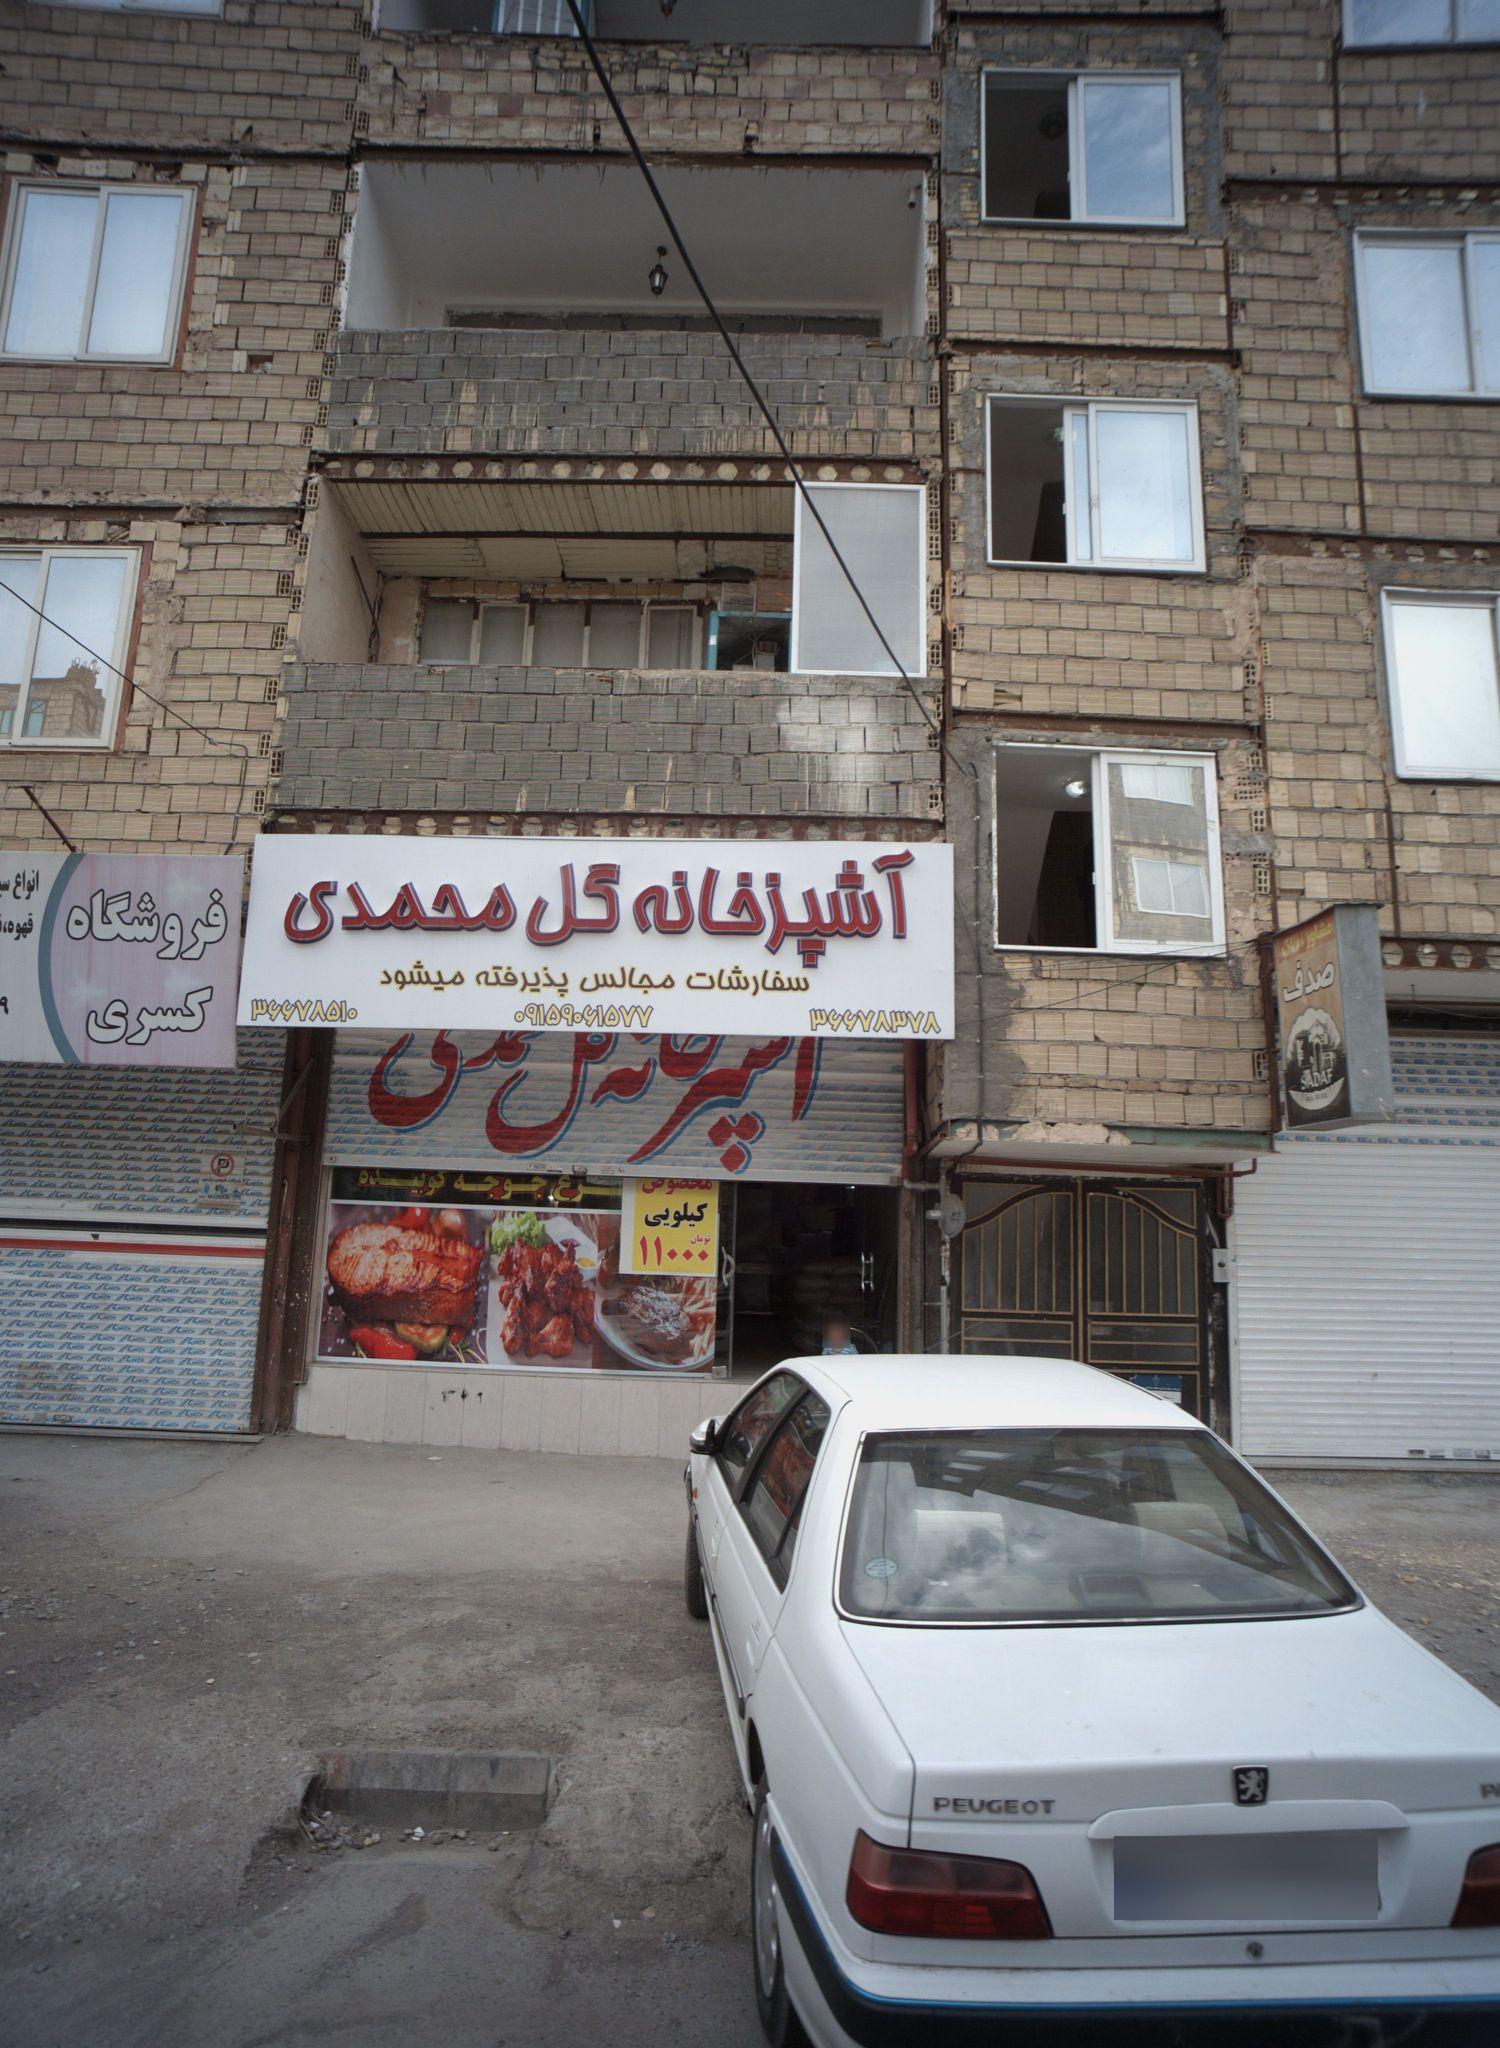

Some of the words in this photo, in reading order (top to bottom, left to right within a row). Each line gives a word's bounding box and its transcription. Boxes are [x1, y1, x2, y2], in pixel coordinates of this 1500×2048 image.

[13, 869, 39, 900] انواع
[284, 880, 517, 944] محمدی
[526, 863, 621, 947] گل
[633, 849, 915, 969] آشپزخانه
[65, 887, 229, 960] فروشگاه
[380, 960, 465, 991] میشود
[475, 966, 568, 997] پذیرفته
[579, 966, 675, 994] مجالس
[686, 965, 810, 997] سفارشات
[1283, 960, 1335, 1003] صدف
[86, 986, 214, 1046] کسری
[250, 998, 358, 1023] ۳۶۶۷۸۵۱۰
[514, 1003, 654, 1028] ۰۹۱۵۹۰۶۱۵۷۷
[809, 1007, 942, 1034] ۳۶۶۷۸۳۷۸
[1300, 1068, 1334, 1090] SADAF
[453, 1174, 549, 1202] جوجه
[644, 1202, 708, 1228] کیلویی
[640, 1235, 709, 1266] ۱۱۰۰۰
[690, 1234, 711, 1245] تومان
[933, 1795, 1056, 1815] PEUGEOT
